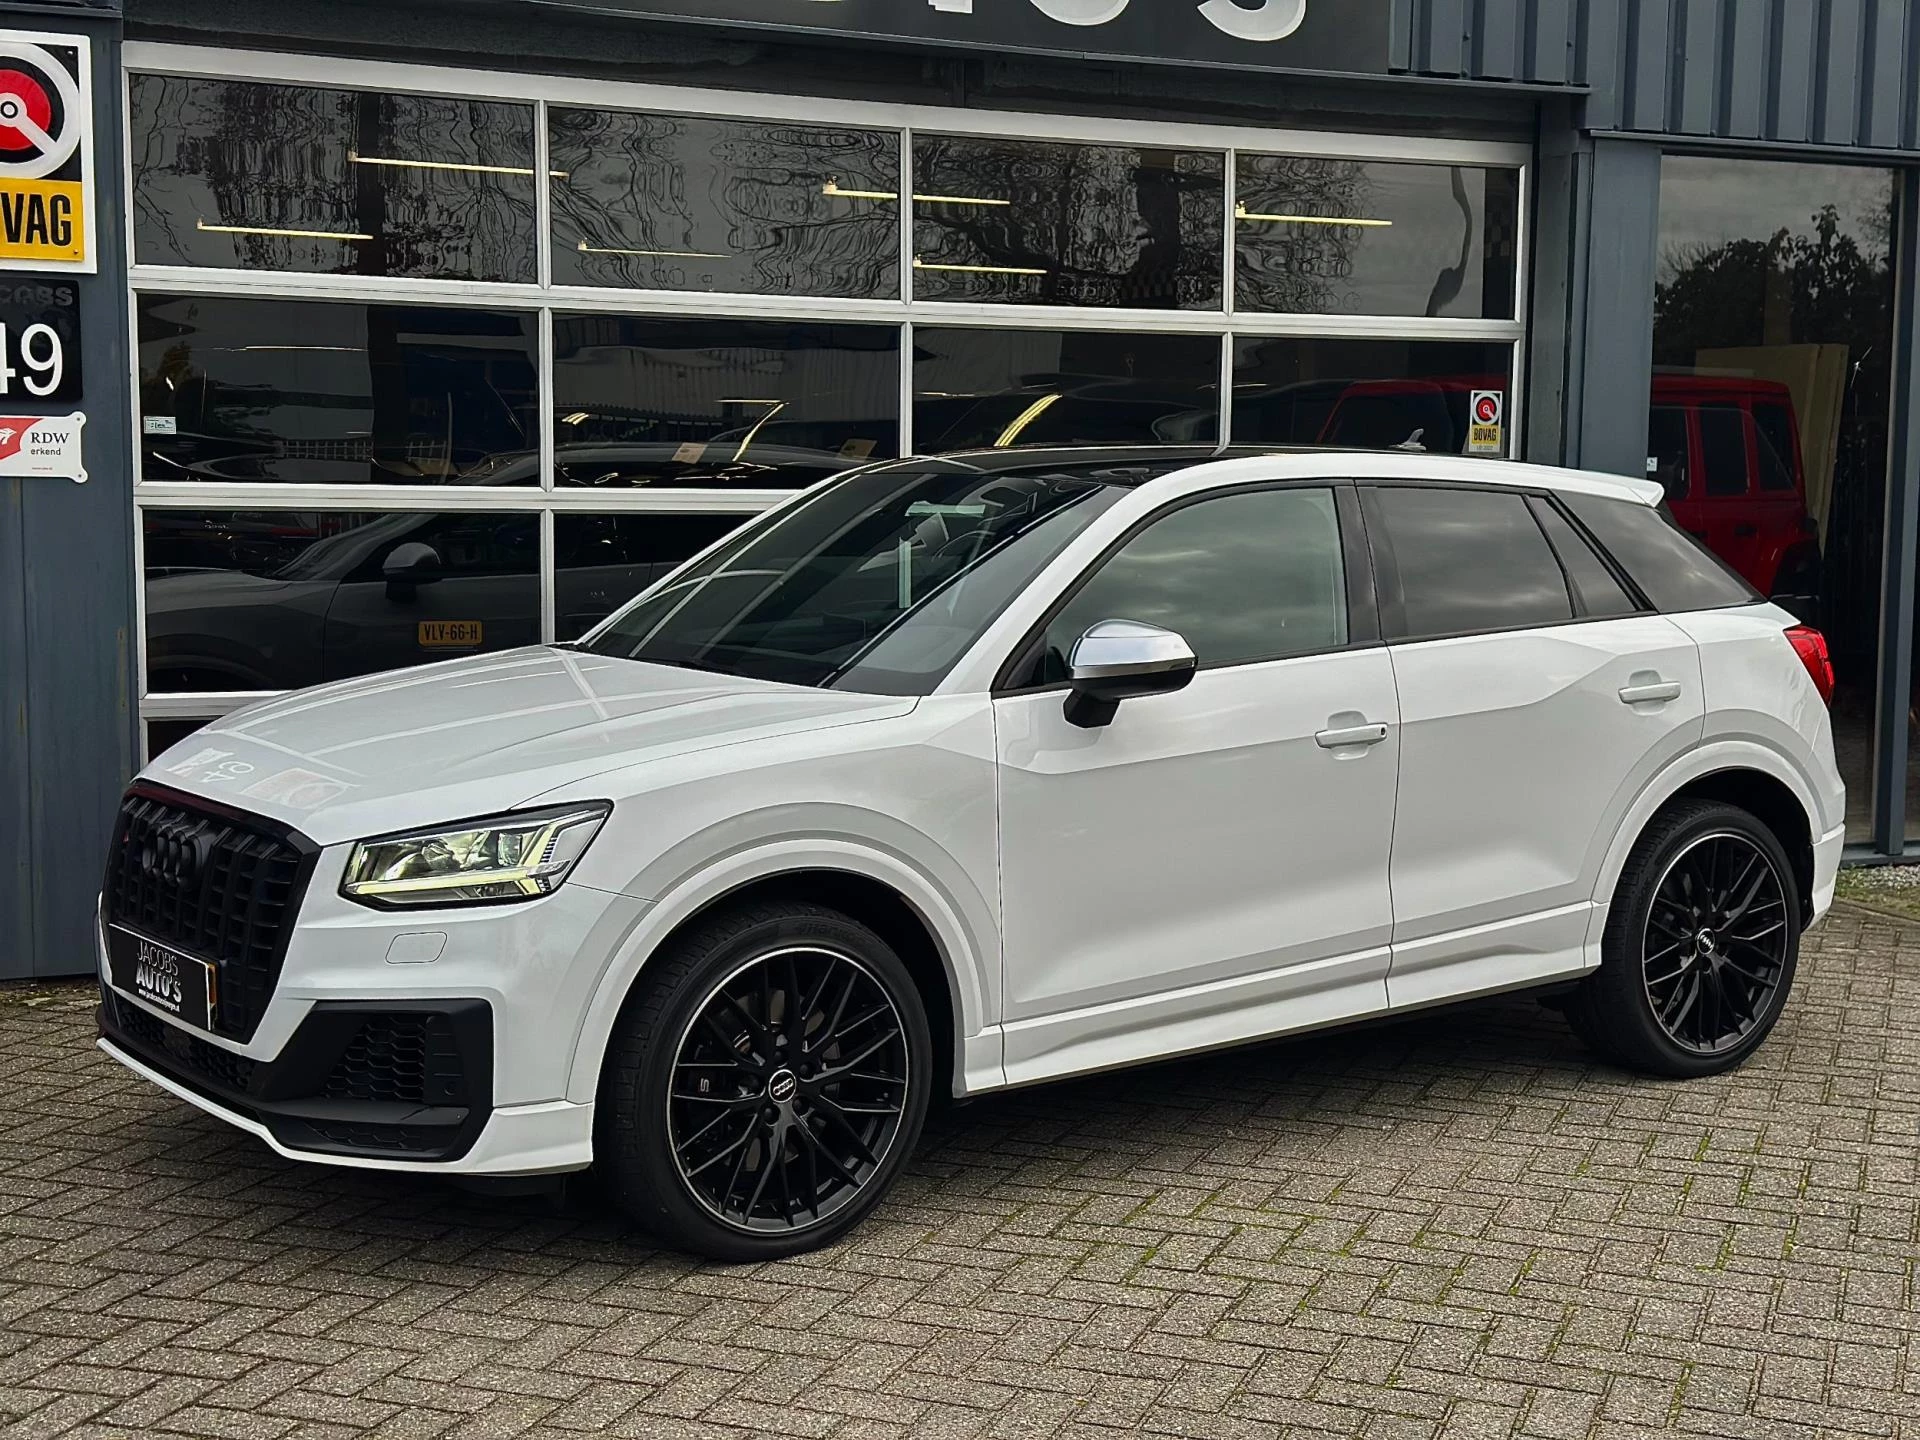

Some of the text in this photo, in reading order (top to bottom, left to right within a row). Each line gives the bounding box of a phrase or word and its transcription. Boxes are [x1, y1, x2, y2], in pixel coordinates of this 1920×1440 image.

[1, 192, 71, 246] VAG
[31, 432, 70, 444] RDW
[1473, 427, 1497, 441] BOVAG
[424, 624, 478, 640] VLV-66-H
[136, 940, 178, 976] JACOBS
[136, 960, 182, 1003] AUTO'S
